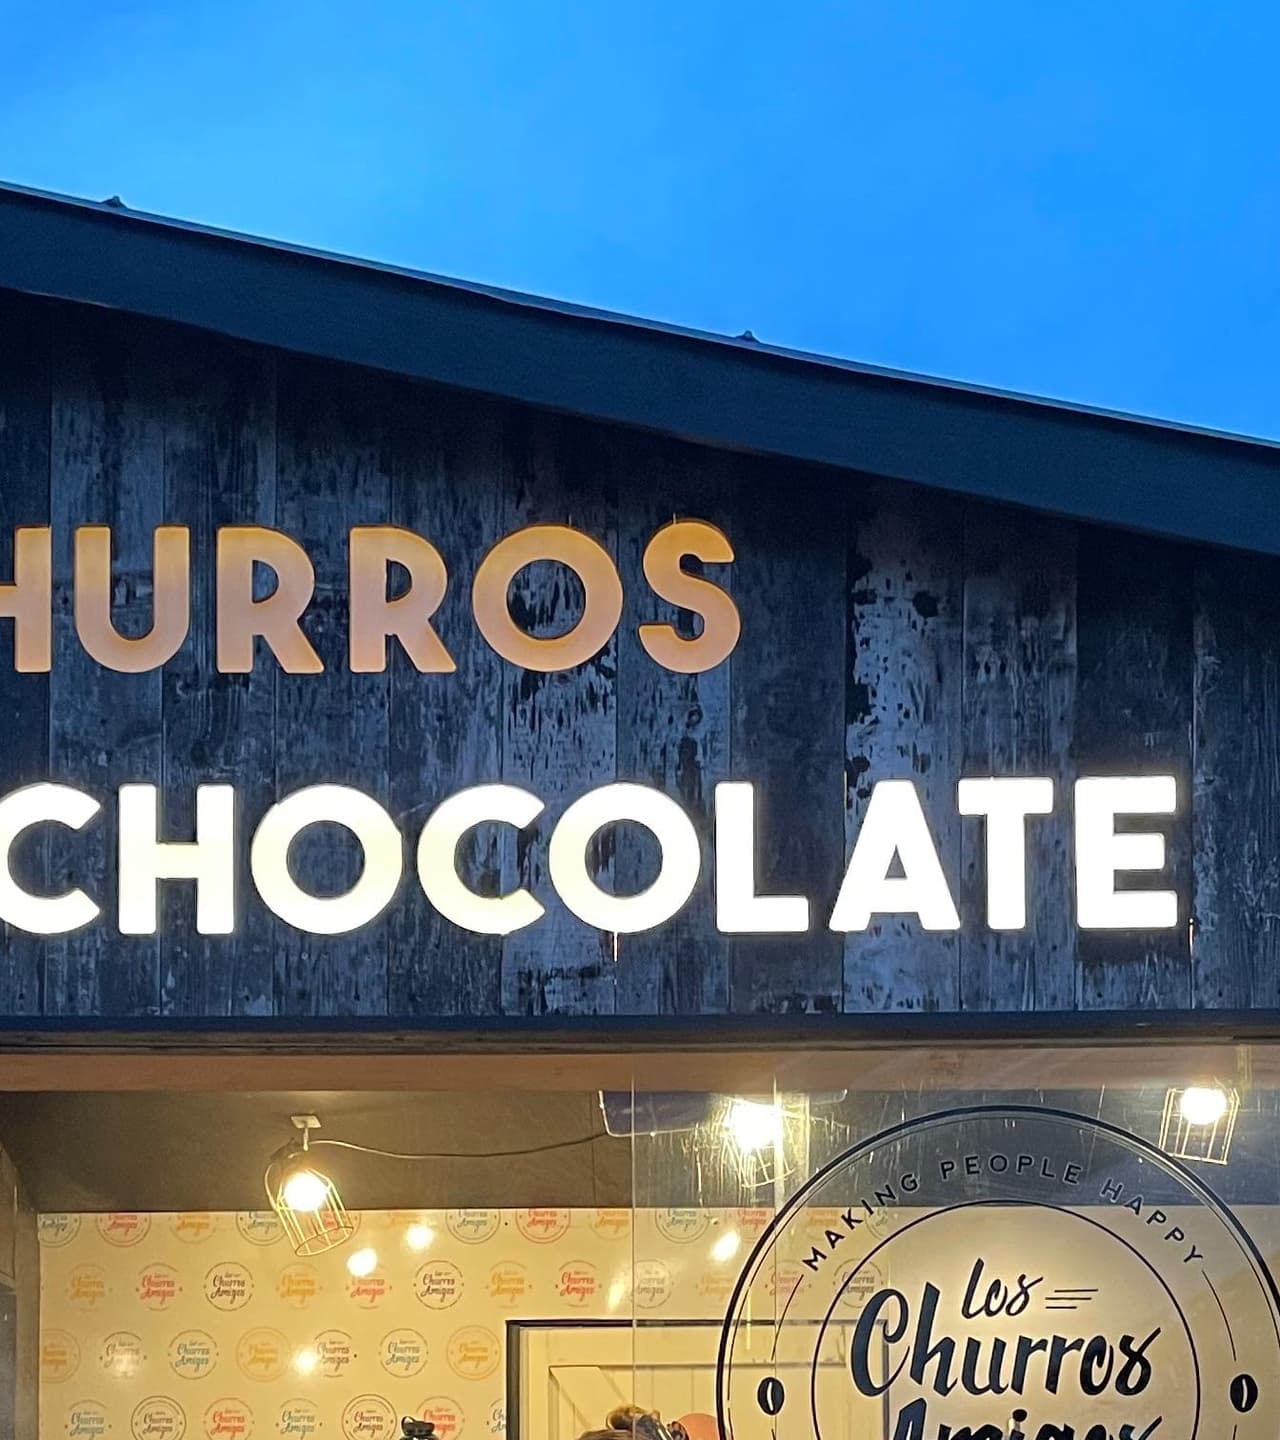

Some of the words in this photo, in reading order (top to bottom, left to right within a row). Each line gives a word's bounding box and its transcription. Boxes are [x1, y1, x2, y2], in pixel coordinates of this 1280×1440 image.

[802, 1172, 919, 1273] MAKING
[940, 1154, 1084, 1184] PEOPLE
[1100, 1178, 1204, 1265] HAPPY
[212, 1274, 245, 1287] Churros
[422, 1274, 455, 1285] Churros
[210, 1287, 245, 1304] Amigos
[420, 1286, 455, 1303] Amigos
[851, 1282, 1161, 1397] Churros
